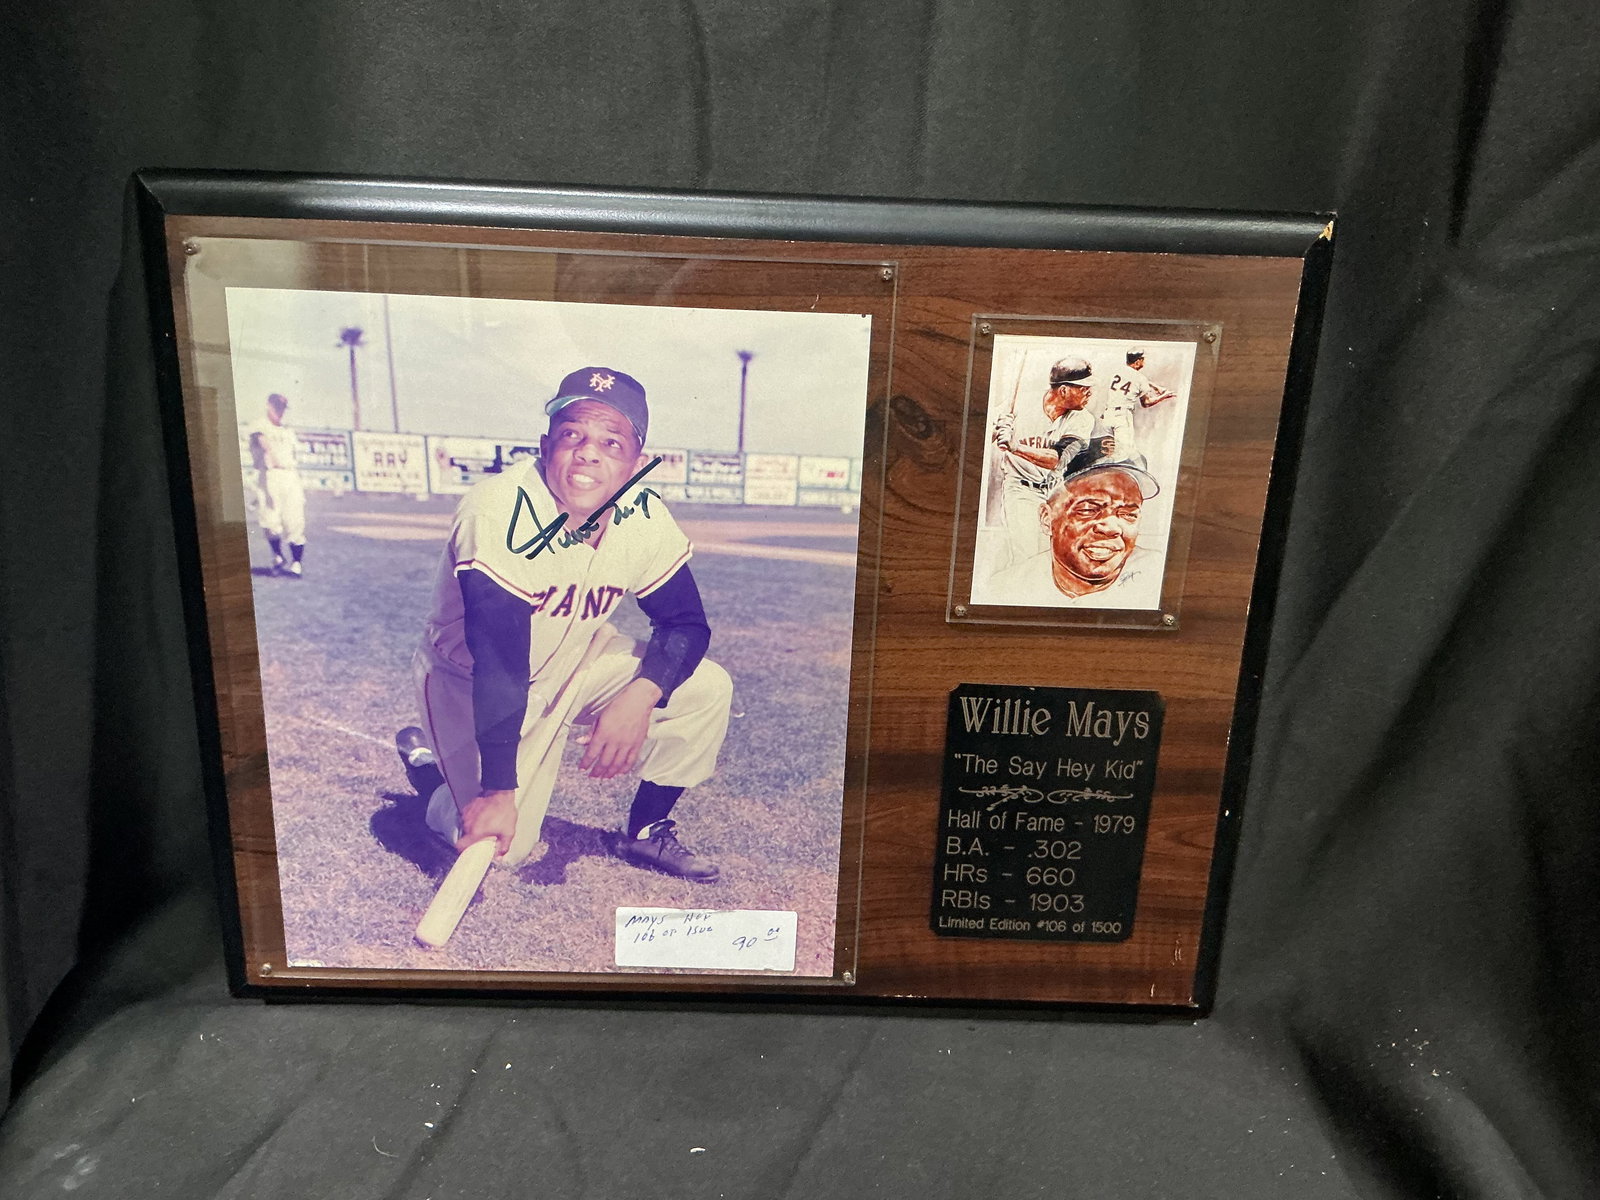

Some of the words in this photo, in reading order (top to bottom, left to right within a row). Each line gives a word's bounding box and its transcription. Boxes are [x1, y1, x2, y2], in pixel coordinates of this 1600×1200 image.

[1110, 375, 1131, 396] 24
[960, 696, 1051, 736] Willie
[1065, 701, 1150, 746] Mays
[955, 753, 998, 774] "The
[1008, 756, 1047, 779] Say
[1057, 758, 1095, 781] Hey
[1105, 760, 1143, 779] Kid"
[948, 809, 980, 828] Hall
[989, 811, 1007, 829] of
[1015, 812, 1065, 832] Fame
[1093, 814, 1136, 834] 1979
[946, 836, 989, 856] B.A.
[1027, 839, 1082, 860] .302
[943, 863, 988, 883] HRs
[1026, 866, 1075, 886] 660
[941, 889, 991, 910] RBIs
[1029, 893, 1085, 913] 1903
[633, 929, 656, 943] 106
[939, 916, 985, 930] Limited
[990, 918, 1031, 932] Edition
[1037, 921, 1067, 933] #106
[1073, 922, 1086, 933] of
[1092, 922, 1122, 934] 1500
[732, 936, 758, 950] 90
